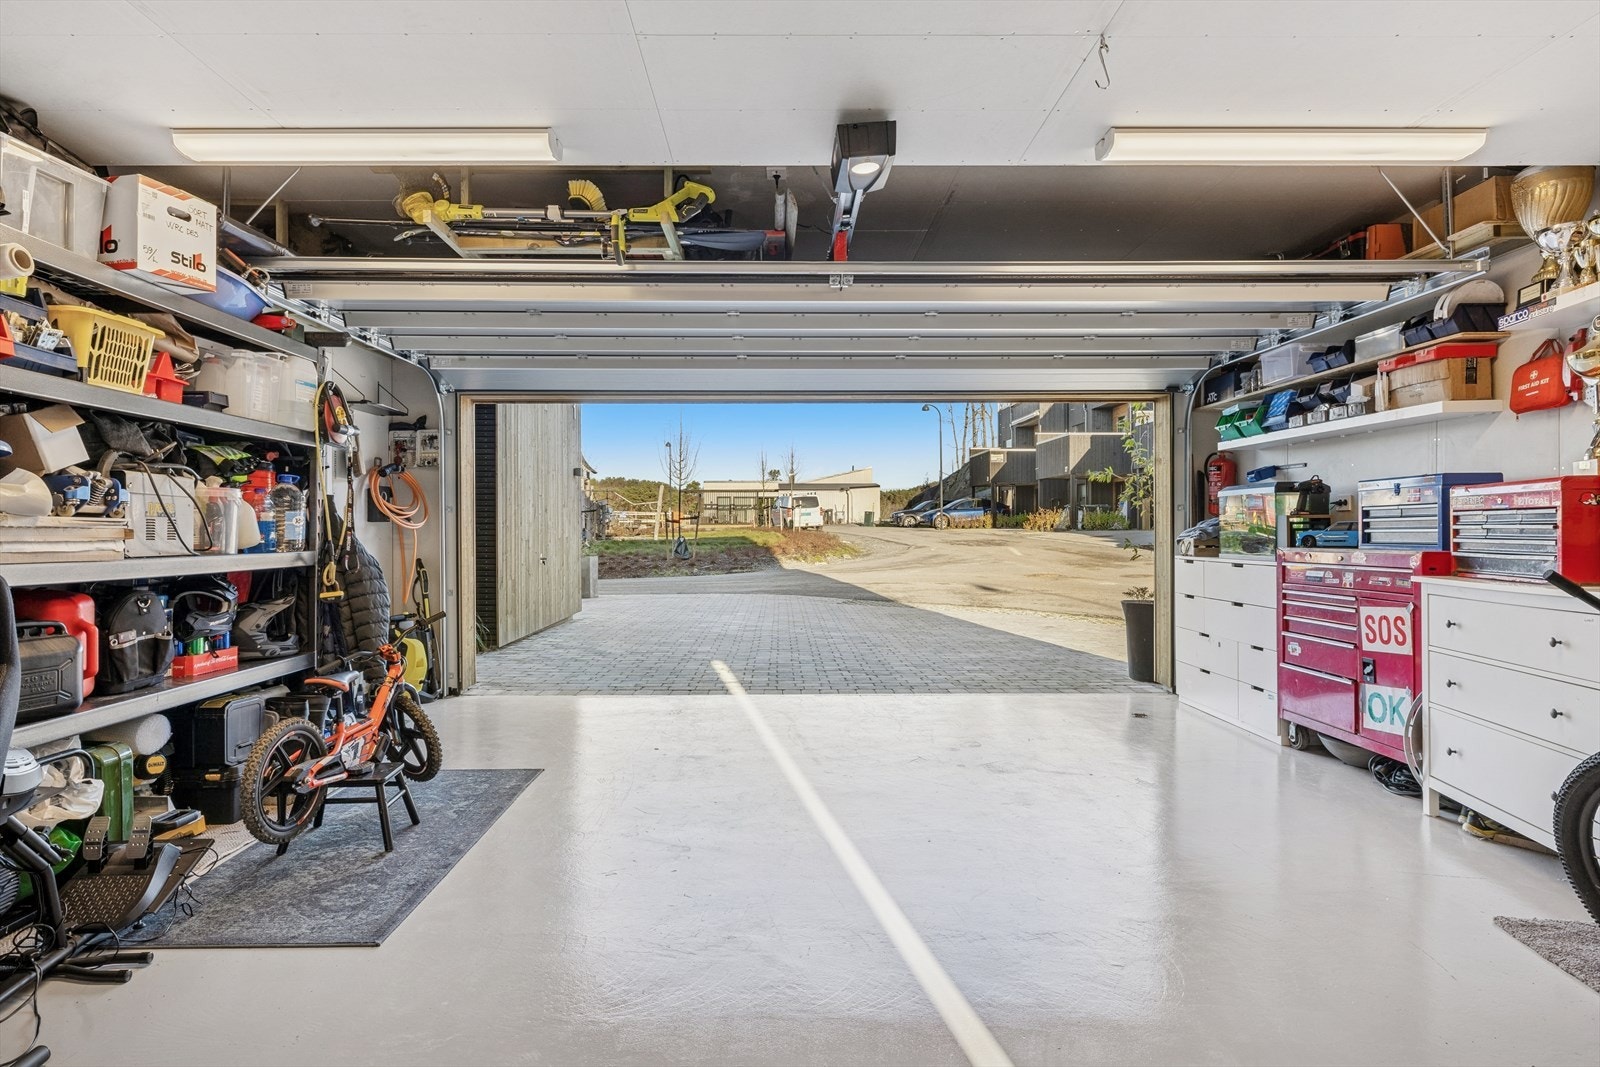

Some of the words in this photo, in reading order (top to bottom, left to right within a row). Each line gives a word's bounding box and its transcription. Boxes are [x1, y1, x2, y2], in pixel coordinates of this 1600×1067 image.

[171, 250, 207, 273] Stilo
[1498, 309, 1529, 328] sparco
[1518, 383, 1530, 391] FIRST
[1531, 380, 1540, 388] AID
[1364, 614, 1407, 647] SOS
[1367, 691, 1406, 727] OK
